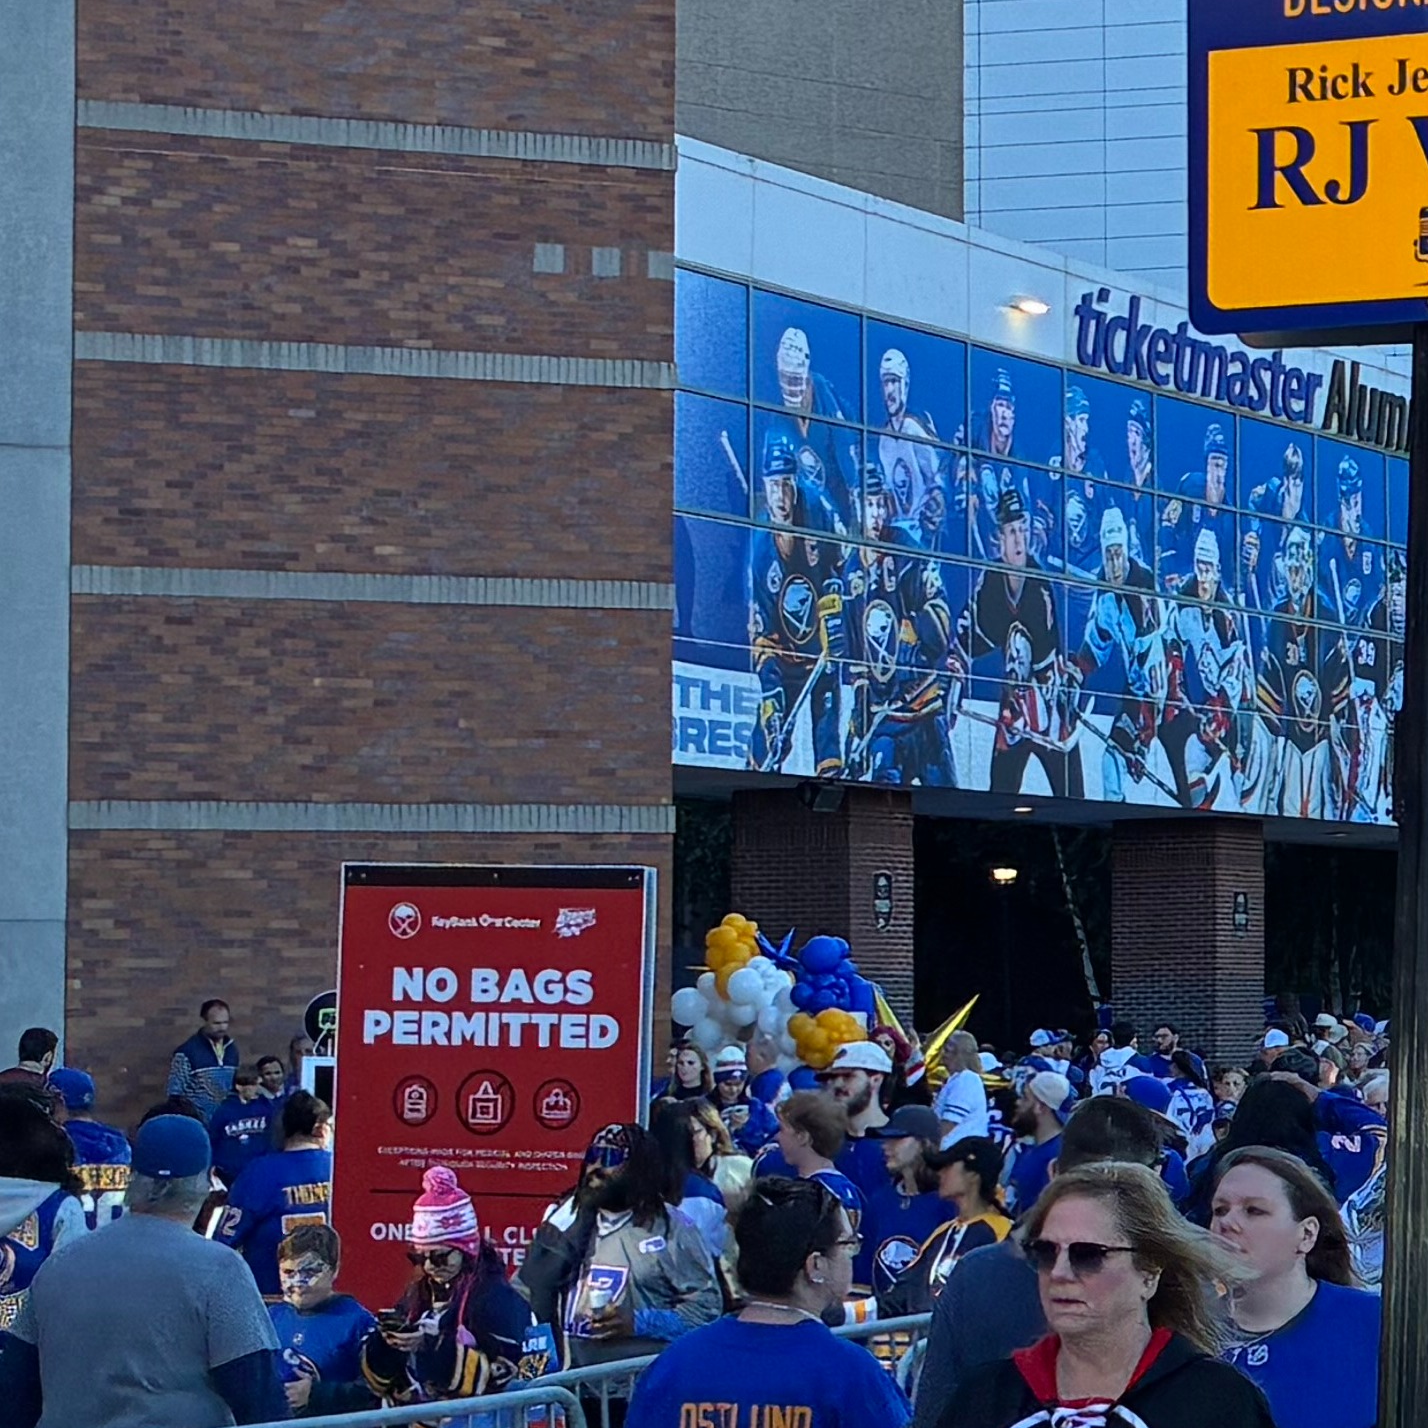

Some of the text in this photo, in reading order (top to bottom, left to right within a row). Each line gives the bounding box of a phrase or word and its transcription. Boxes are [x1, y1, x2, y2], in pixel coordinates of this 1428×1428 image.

[1286, 62, 1375, 104] Rick
[1247, 118, 1379, 211] RJ
[1074, 287, 1412, 452] ticketmaster Alum
[673, 674, 761, 716] THE
[672, 716, 752, 759] RES
[392, 967, 594, 1005] NO BAGS
[363, 1009, 620, 1049] PERMITTED
